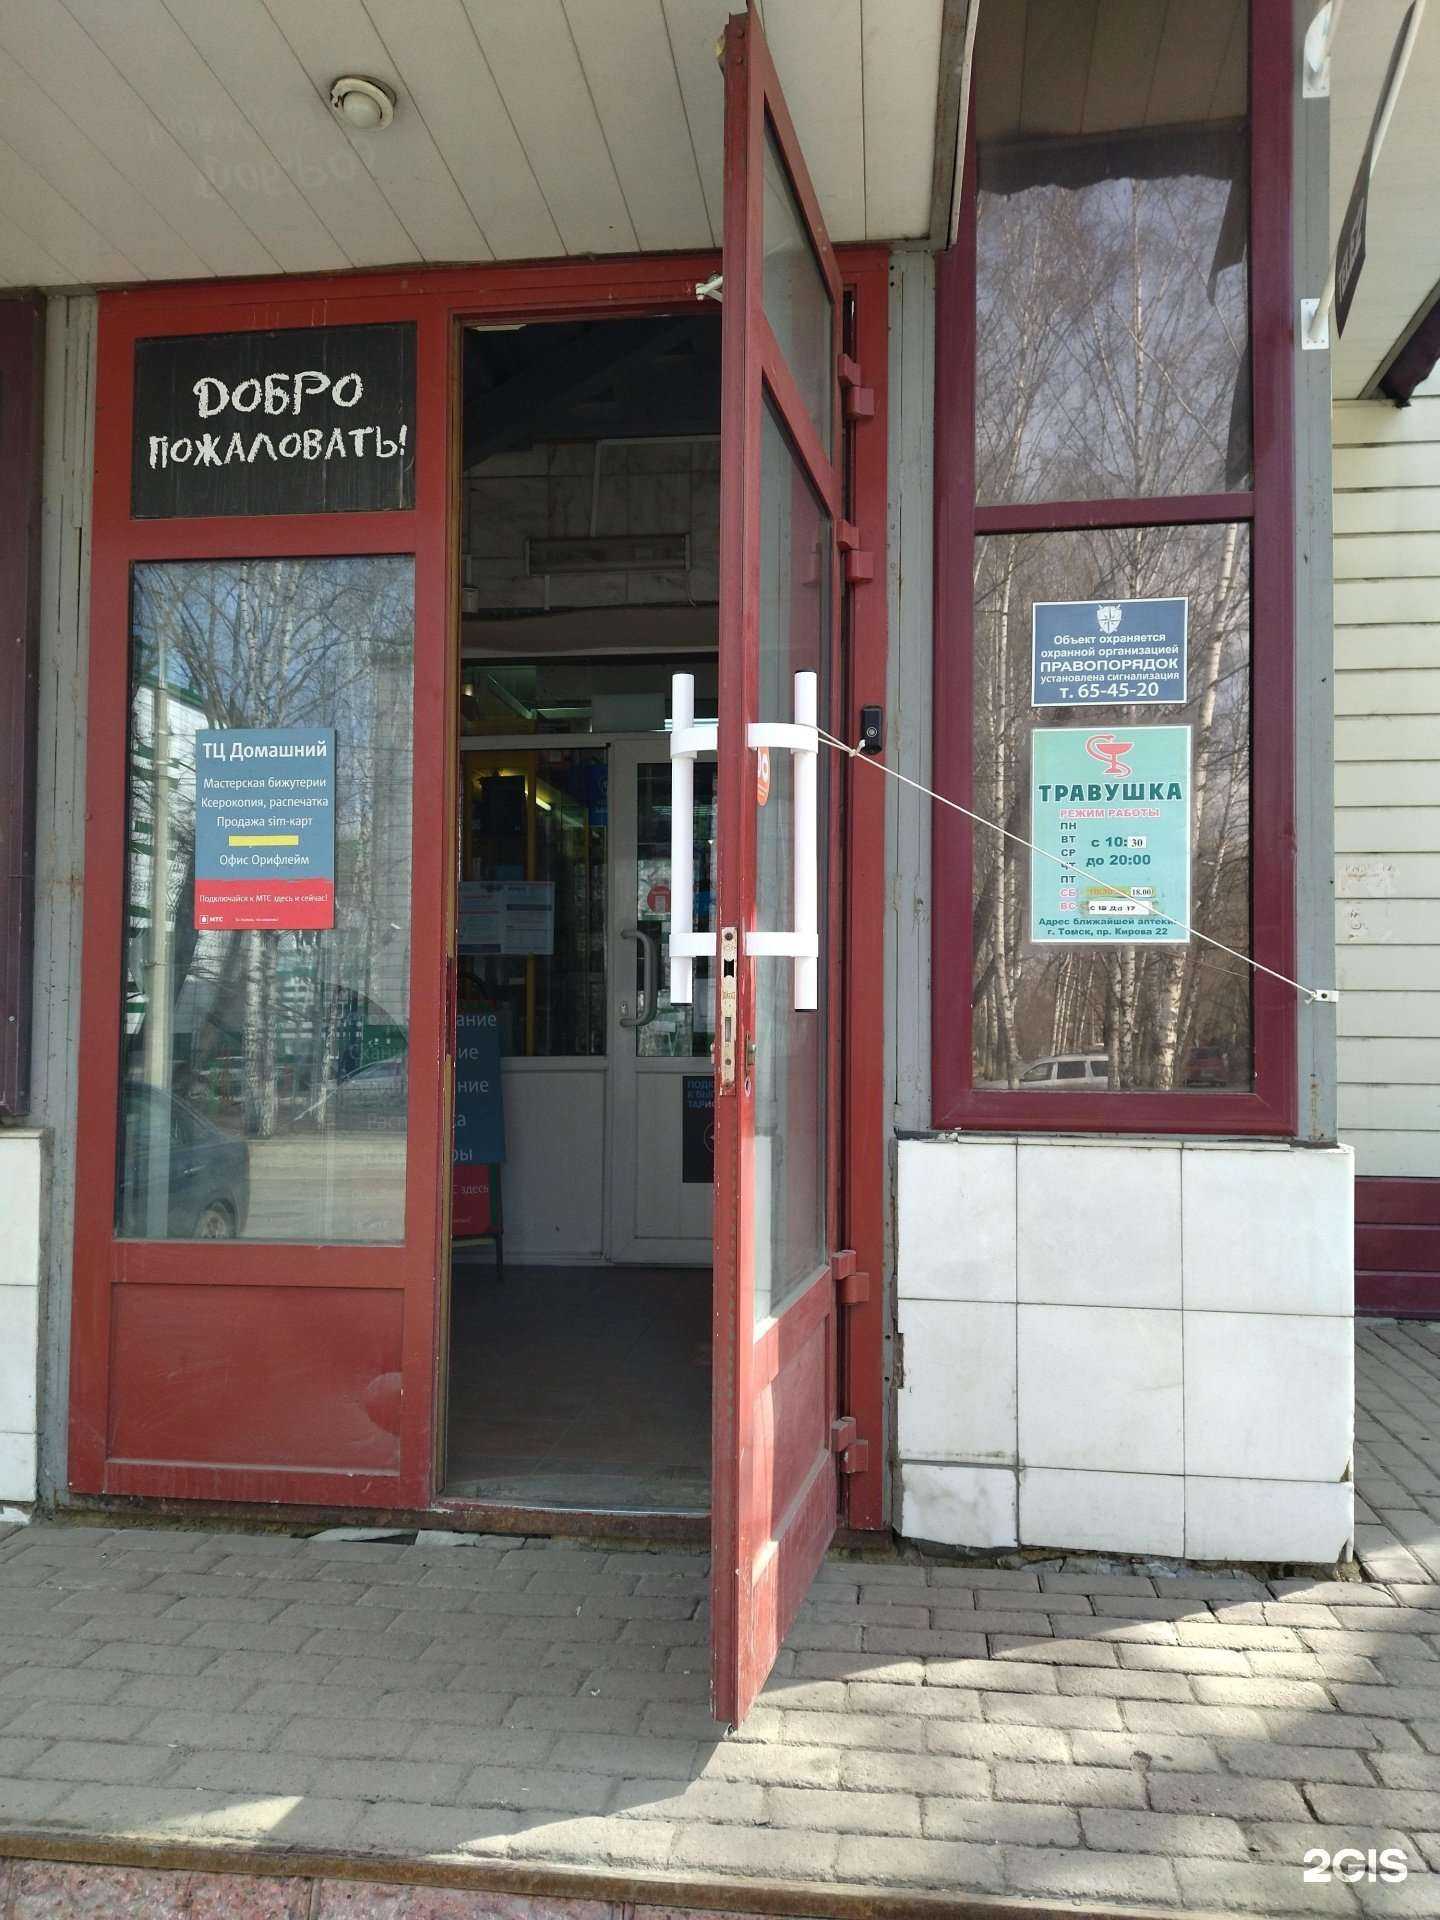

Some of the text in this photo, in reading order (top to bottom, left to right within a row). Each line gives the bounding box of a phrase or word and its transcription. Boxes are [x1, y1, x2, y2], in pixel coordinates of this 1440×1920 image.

[193, 370, 363, 418] ДОБРО
[149, 425, 407, 468] ПОЖАЛОВАТЬ!
[1054, 634, 1166, 645] Объект охраняется
[1041, 645, 1179, 659] охранной организацией
[1040, 658, 1178, 673] ПРАВОПОРЯДОК
[1041, 672, 1179, 684] установлена сигнализация
[1078, 682, 1159, 698] 65-45-20
[203, 741, 327, 762] ТЦ Домашний
[204, 777, 326, 789] Мастерская бижутерии
[1039, 783, 1182, 802] ТРАВУШКА
[201, 798, 328, 809] Ксерокопия, распечатка
[1060, 808, 1160, 818] РЕЖИМ РАБОТЫ
[217, 816, 312, 828] Продажа sim-карт
[1060, 822, 1076, 830] ПН
[1061, 849, 1076, 857] СР
[220, 853, 310, 866] Офис Орифлейм
[1086, 854, 1150, 868] до 20:00
[1038, 918, 1070, 926] Адрес
[1058, 928, 1093, 936] Томск,
[1115, 927, 1152, 936] Кирова
